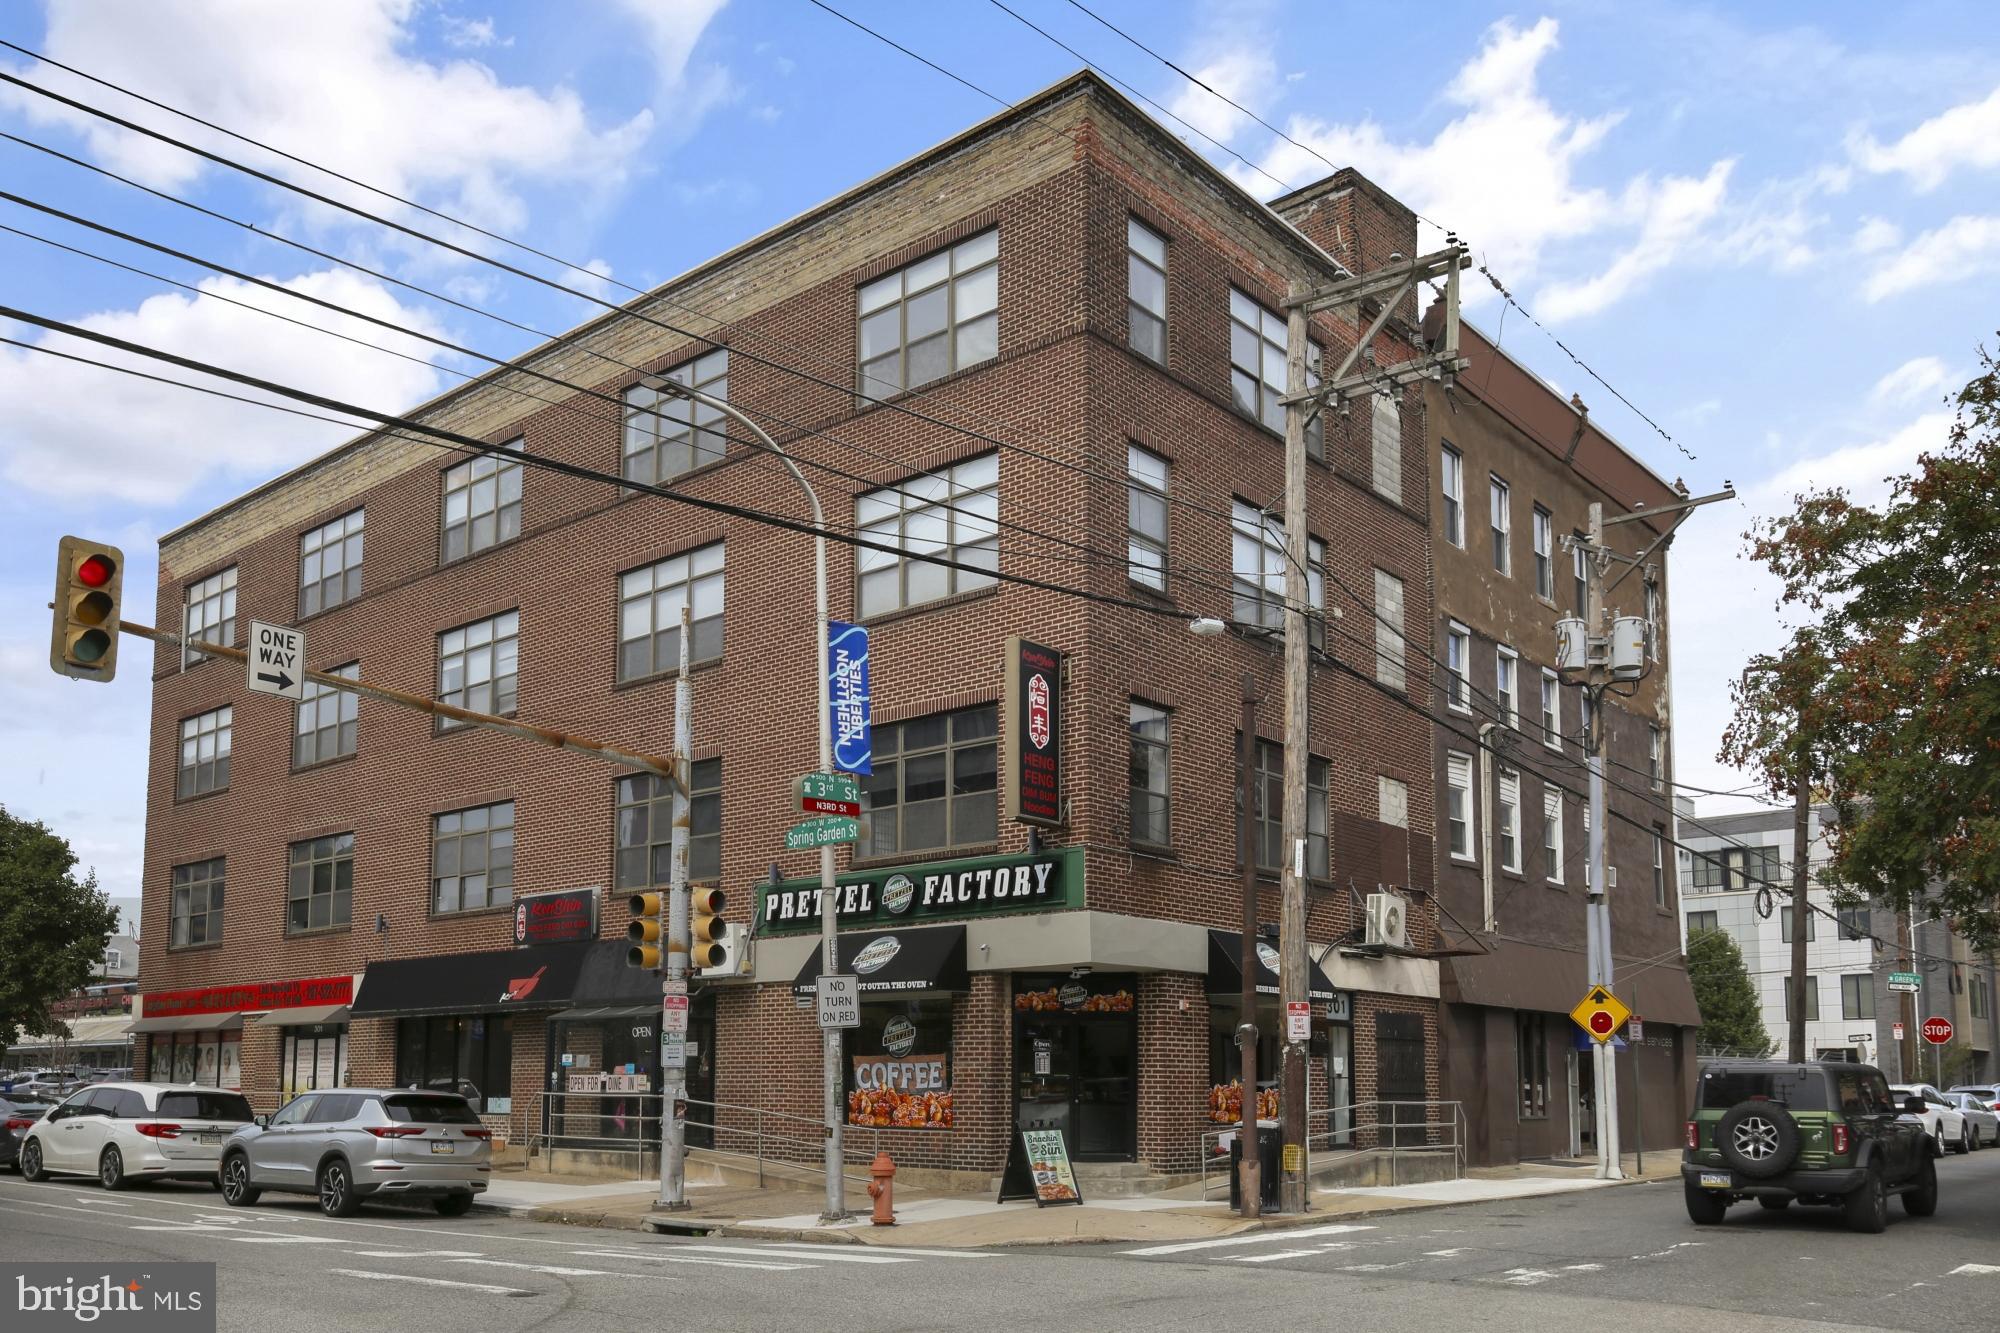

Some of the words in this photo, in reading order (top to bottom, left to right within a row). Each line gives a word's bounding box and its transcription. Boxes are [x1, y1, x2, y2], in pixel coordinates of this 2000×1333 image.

[260, 629, 296, 651] ONE
[260, 647, 296, 669] WAY
[837, 649, 851, 746] NORTHERN
[850, 659, 864, 740] LIBERTIES
[1024, 752, 1056, 771] HENG
[1024, 768, 1056, 788] FENG
[818, 782, 834, 797] 3rd
[844, 787, 858, 800] St
[816, 801, 837, 811] N3RD
[839, 804, 847, 812] St
[788, 831, 814, 848] Spring
[817, 826, 846, 842] Garden
[849, 823, 857, 837] St
[922, 863, 1052, 905] FACTORY
[830, 981, 845, 992] NO
[825, 997, 852, 1007] TURN
[823, 1012, 836, 1022] ON
[839, 1011, 855, 1021] RED
[632, 1026, 652, 1038] OPEN
[886, 1029, 913, 1043] PRETZEL
[1924, 1025, 1951, 1036] STOP
[663, 1034, 669, 1044] 3
[889, 1039, 913, 1052] FACTORY
[856, 1062, 942, 1089] COFFEE
[570, 1077, 585, 1091] OPEN
[587, 1077, 599, 1090] FOR
[608, 1077, 622, 1090] DINE
[627, 1077, 634, 1090] IN
[1041, 1144, 1062, 1156] Sun
